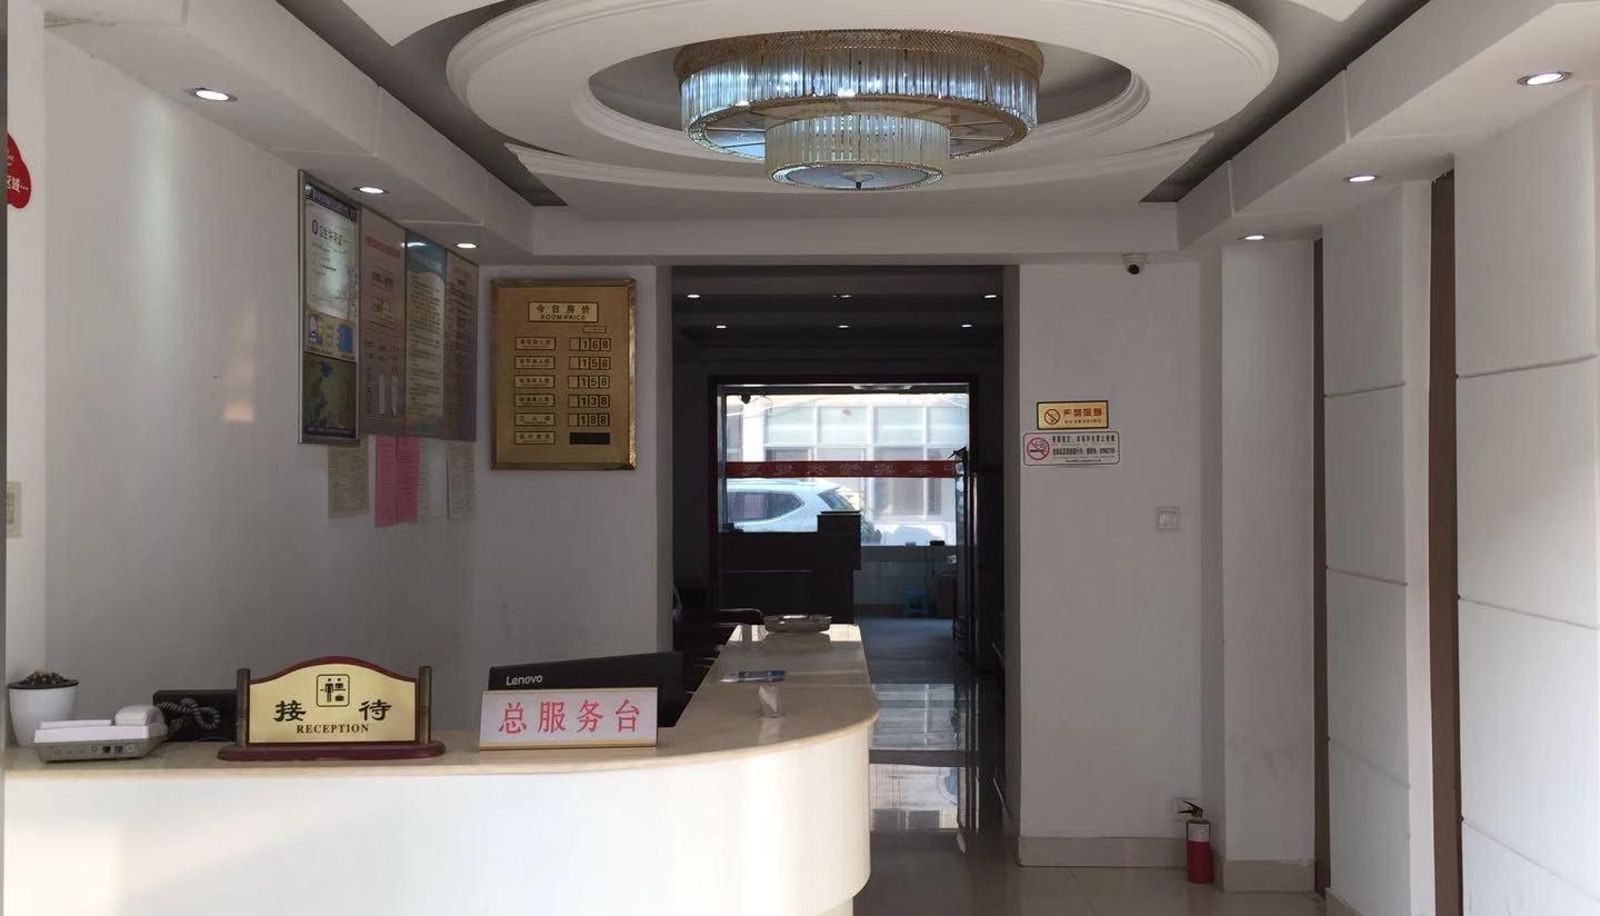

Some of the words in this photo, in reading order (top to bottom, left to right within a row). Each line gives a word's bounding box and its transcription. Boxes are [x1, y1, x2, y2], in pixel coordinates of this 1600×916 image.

[537, 304, 590, 315] 今日房价
[583, 340, 609, 349] 168
[582, 377, 608, 387] 158
[581, 397, 607, 406] 138
[581, 415, 607, 425] 188
[506, 674, 543, 686] Lenovo
[274, 699, 392, 722] 接待
[498, 699, 641, 734] 总服务台
[296, 723, 370, 735] RECEPTION
